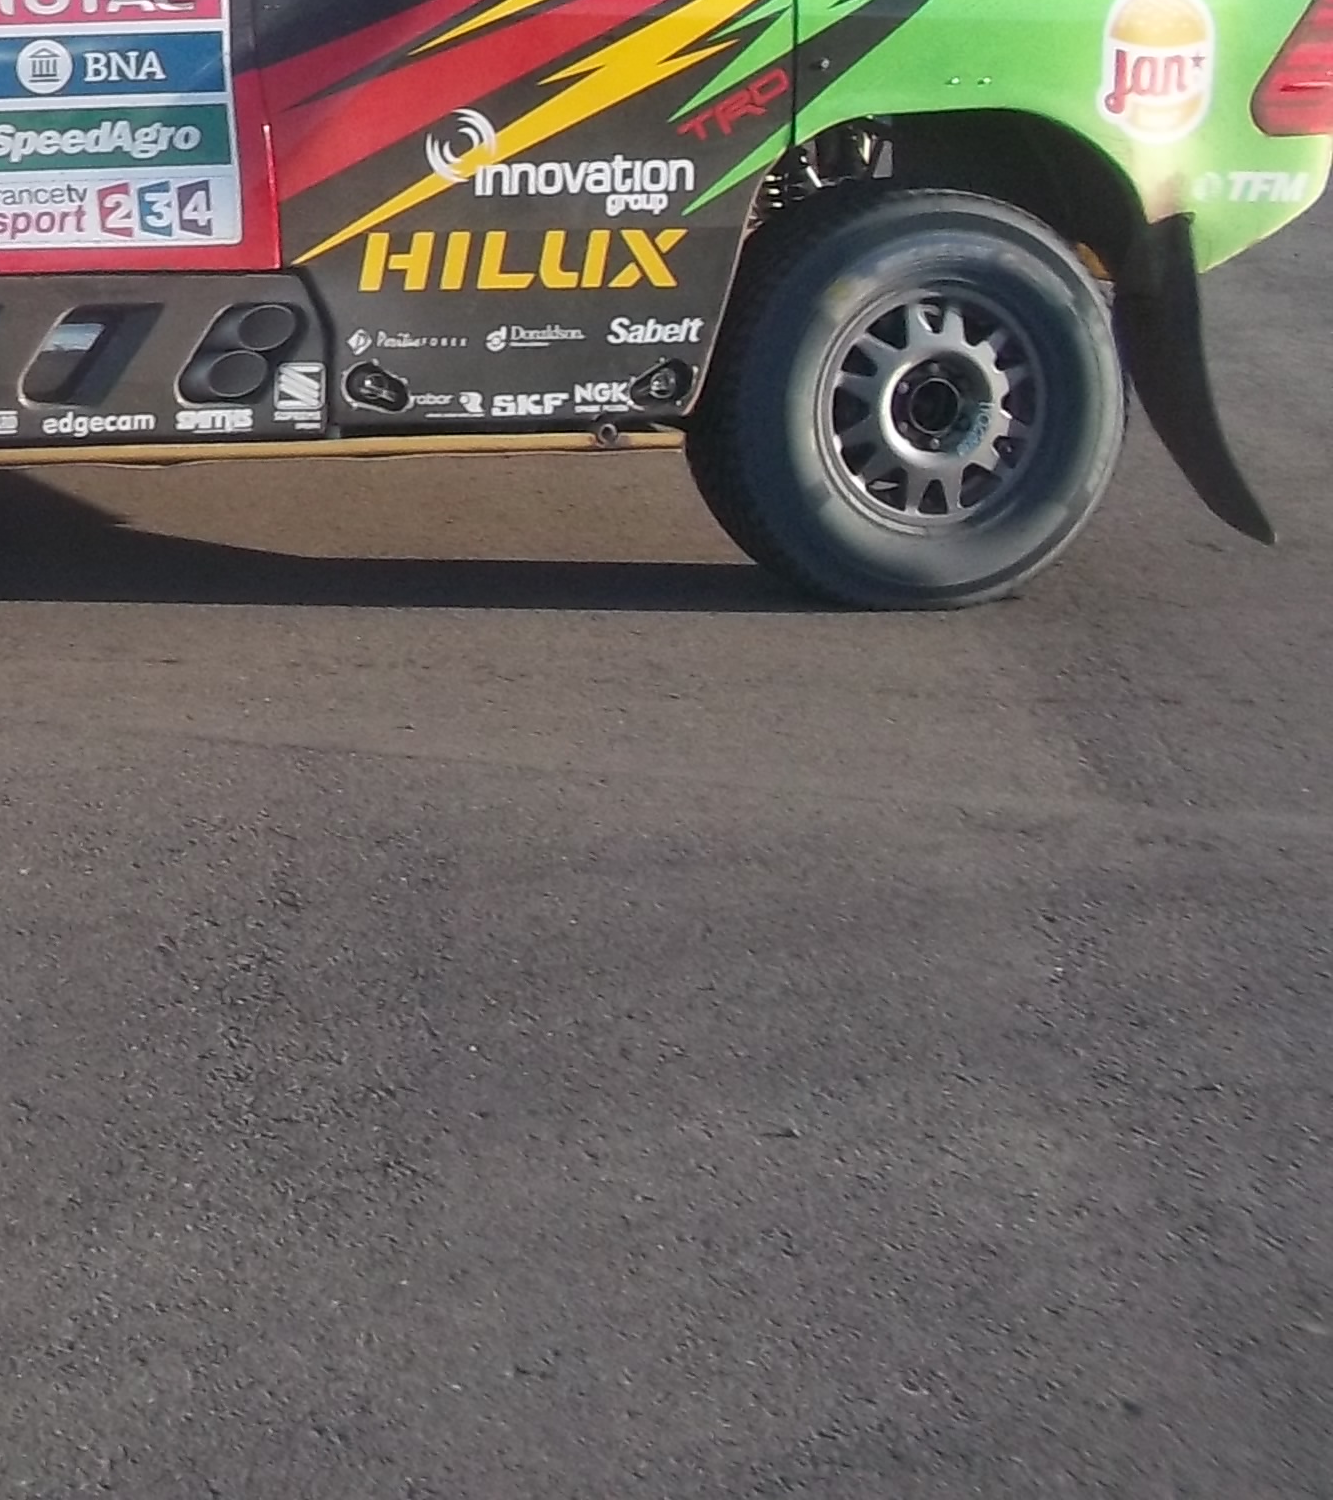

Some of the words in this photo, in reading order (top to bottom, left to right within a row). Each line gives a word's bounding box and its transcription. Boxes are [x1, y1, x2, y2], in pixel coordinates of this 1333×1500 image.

[83, 50, 166, 82] BNA
[676, 67, 791, 141] TRD
[474, 154, 695, 197] innovation
[1227, 170, 1309, 204] TFM
[605, 193, 668, 217] group
[358, 228, 689, 292] HILUX
[606, 317, 705, 345] Sabelt
[490, 392, 570, 418] SKF
[574, 381, 629, 403] NGK
[41, 411, 156, 438] edgecam
